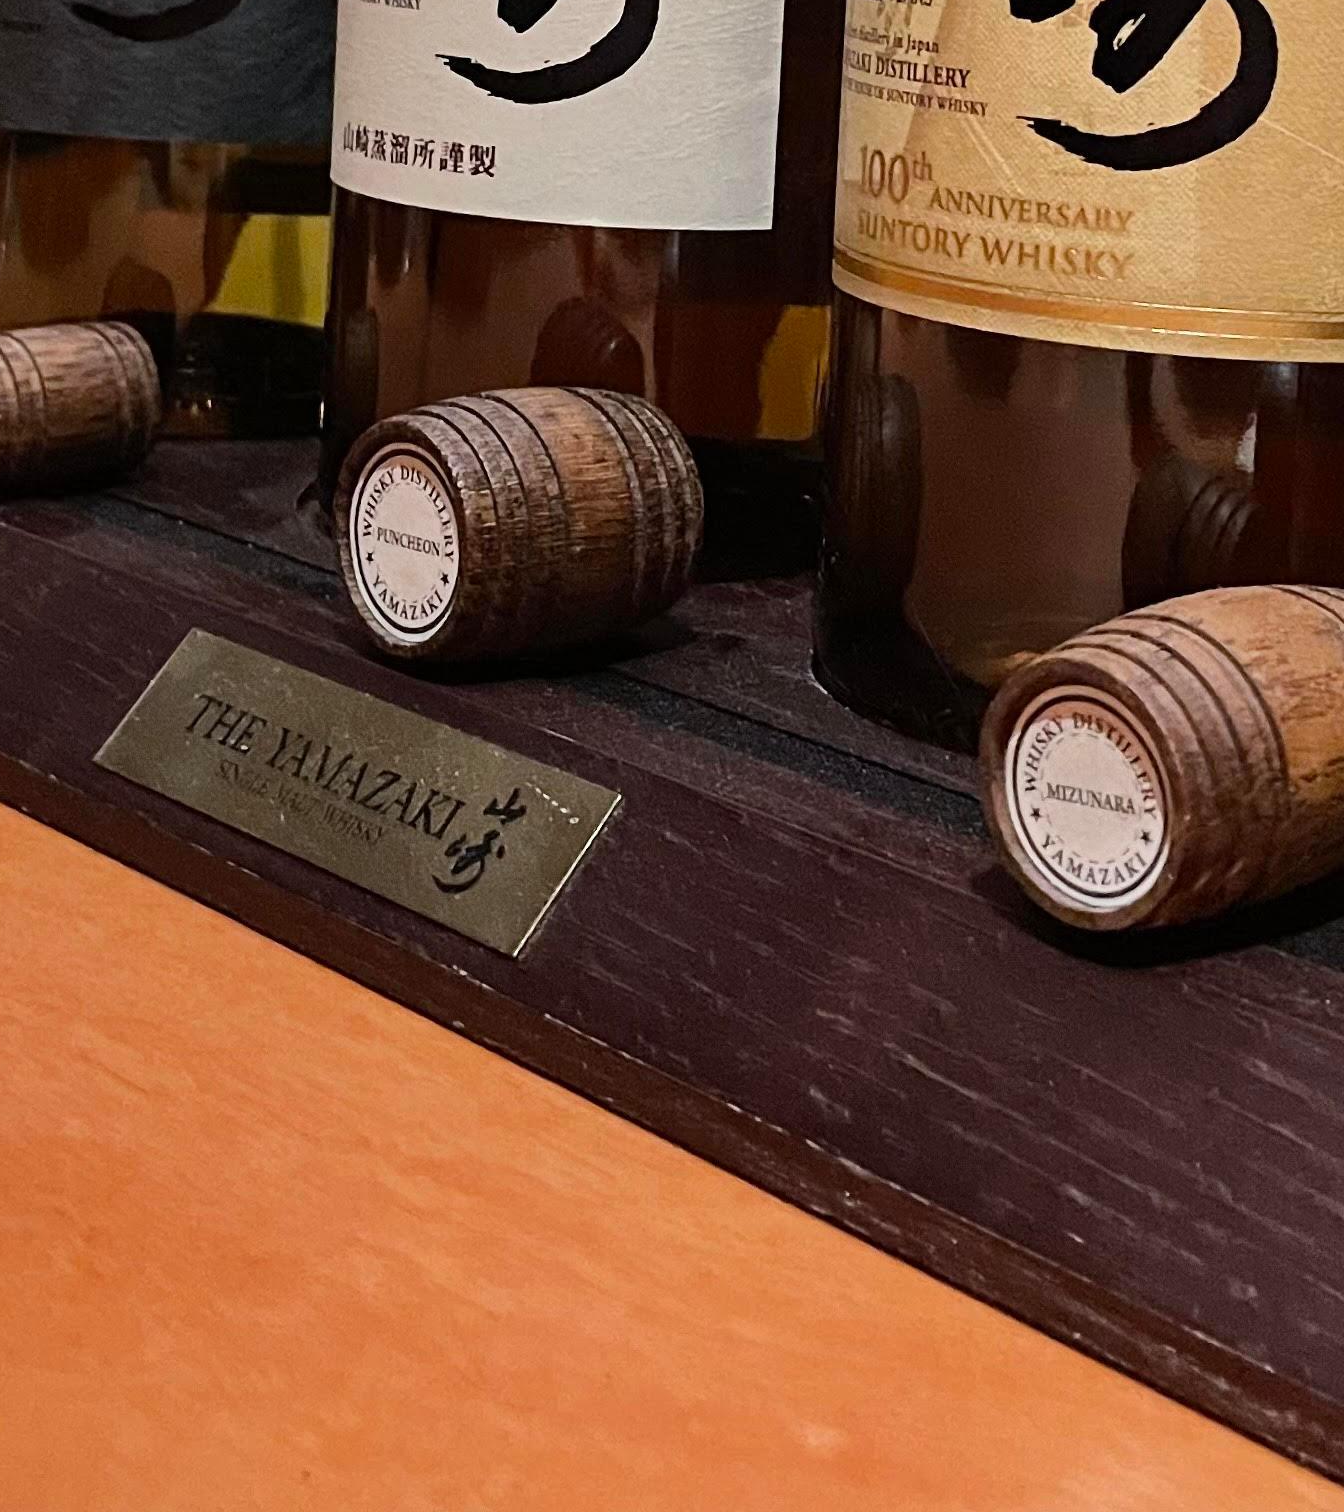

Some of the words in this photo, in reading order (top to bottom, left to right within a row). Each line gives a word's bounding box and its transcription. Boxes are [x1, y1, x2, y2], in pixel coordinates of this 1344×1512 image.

[906, 33, 940, 56] Japan
[875, 55, 972, 89] DISTILLERY
[937, 96, 989, 117] WHISKY
[929, 186, 1136, 233] ANNIVERSARY
[858, 208, 972, 259] SUNTORY
[980, 236, 1136, 282] WHISKY
[362, 467, 396, 538] WHISKY
[400, 464, 455, 563] DISTILLERY
[377, 526, 441, 557] PUNCHEON
[372, 572, 444, 621] YAMAZAKI
[185, 694, 269, 755] THE
[265, 726, 470, 842] YAMAZAKI
[1024, 717, 1064, 793] WHISKY
[1072, 711, 1158, 820] DISTILLERY
[1046, 782, 1137, 815] MIZUNARA
[1042, 834, 1148, 887] YAMAZAKI
